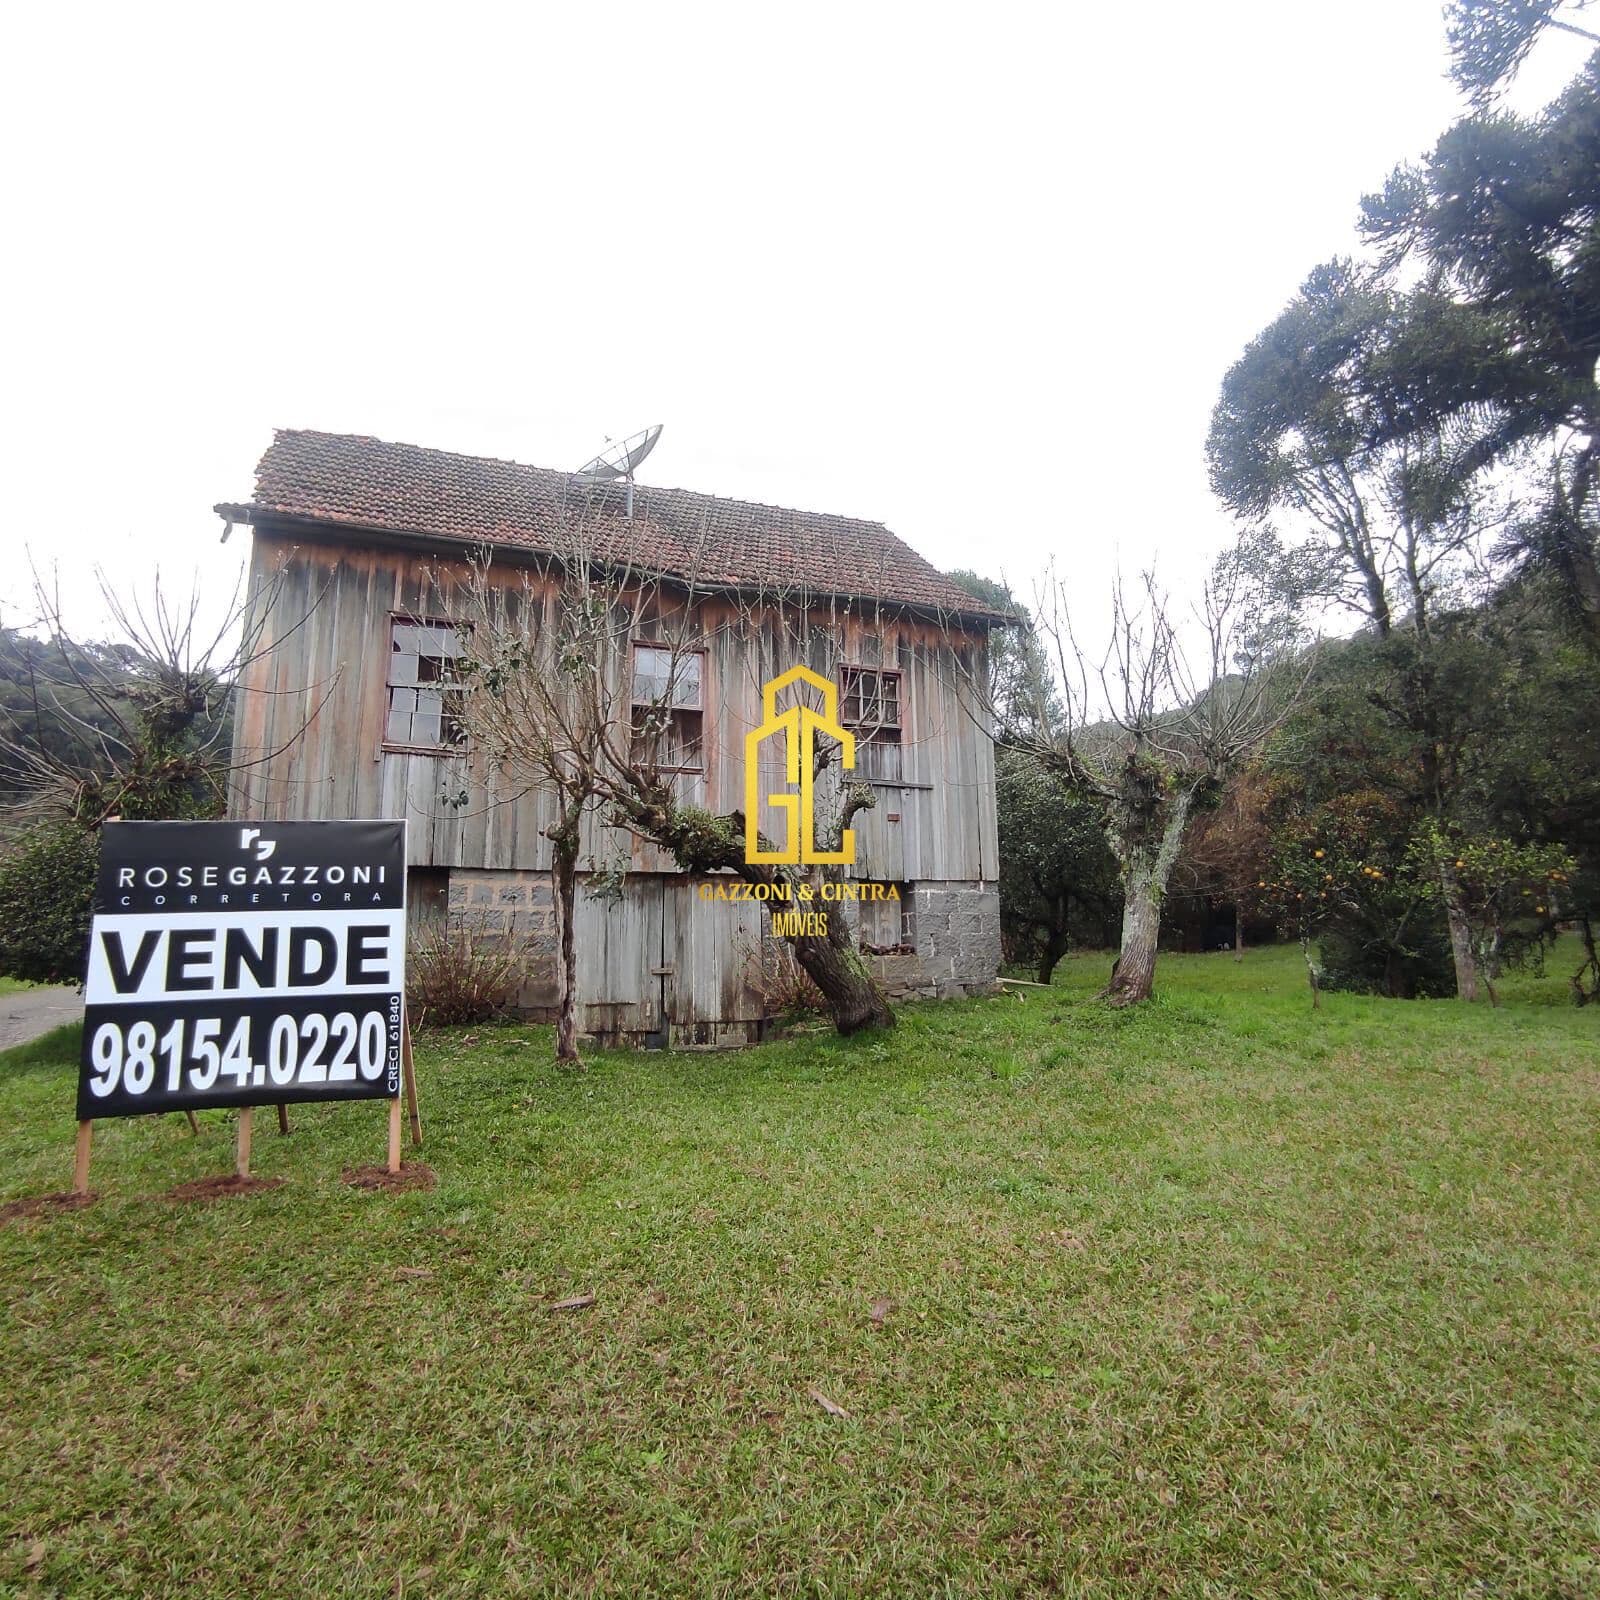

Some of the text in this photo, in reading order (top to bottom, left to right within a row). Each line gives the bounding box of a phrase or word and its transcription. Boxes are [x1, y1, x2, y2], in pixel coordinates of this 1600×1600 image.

[121, 892, 382, 906] CORRETORA
[100, 924, 391, 994] VENDE
[89, 1011, 387, 1098] 98154.0220
[388, 995, 400, 1093] CRECI 61840
